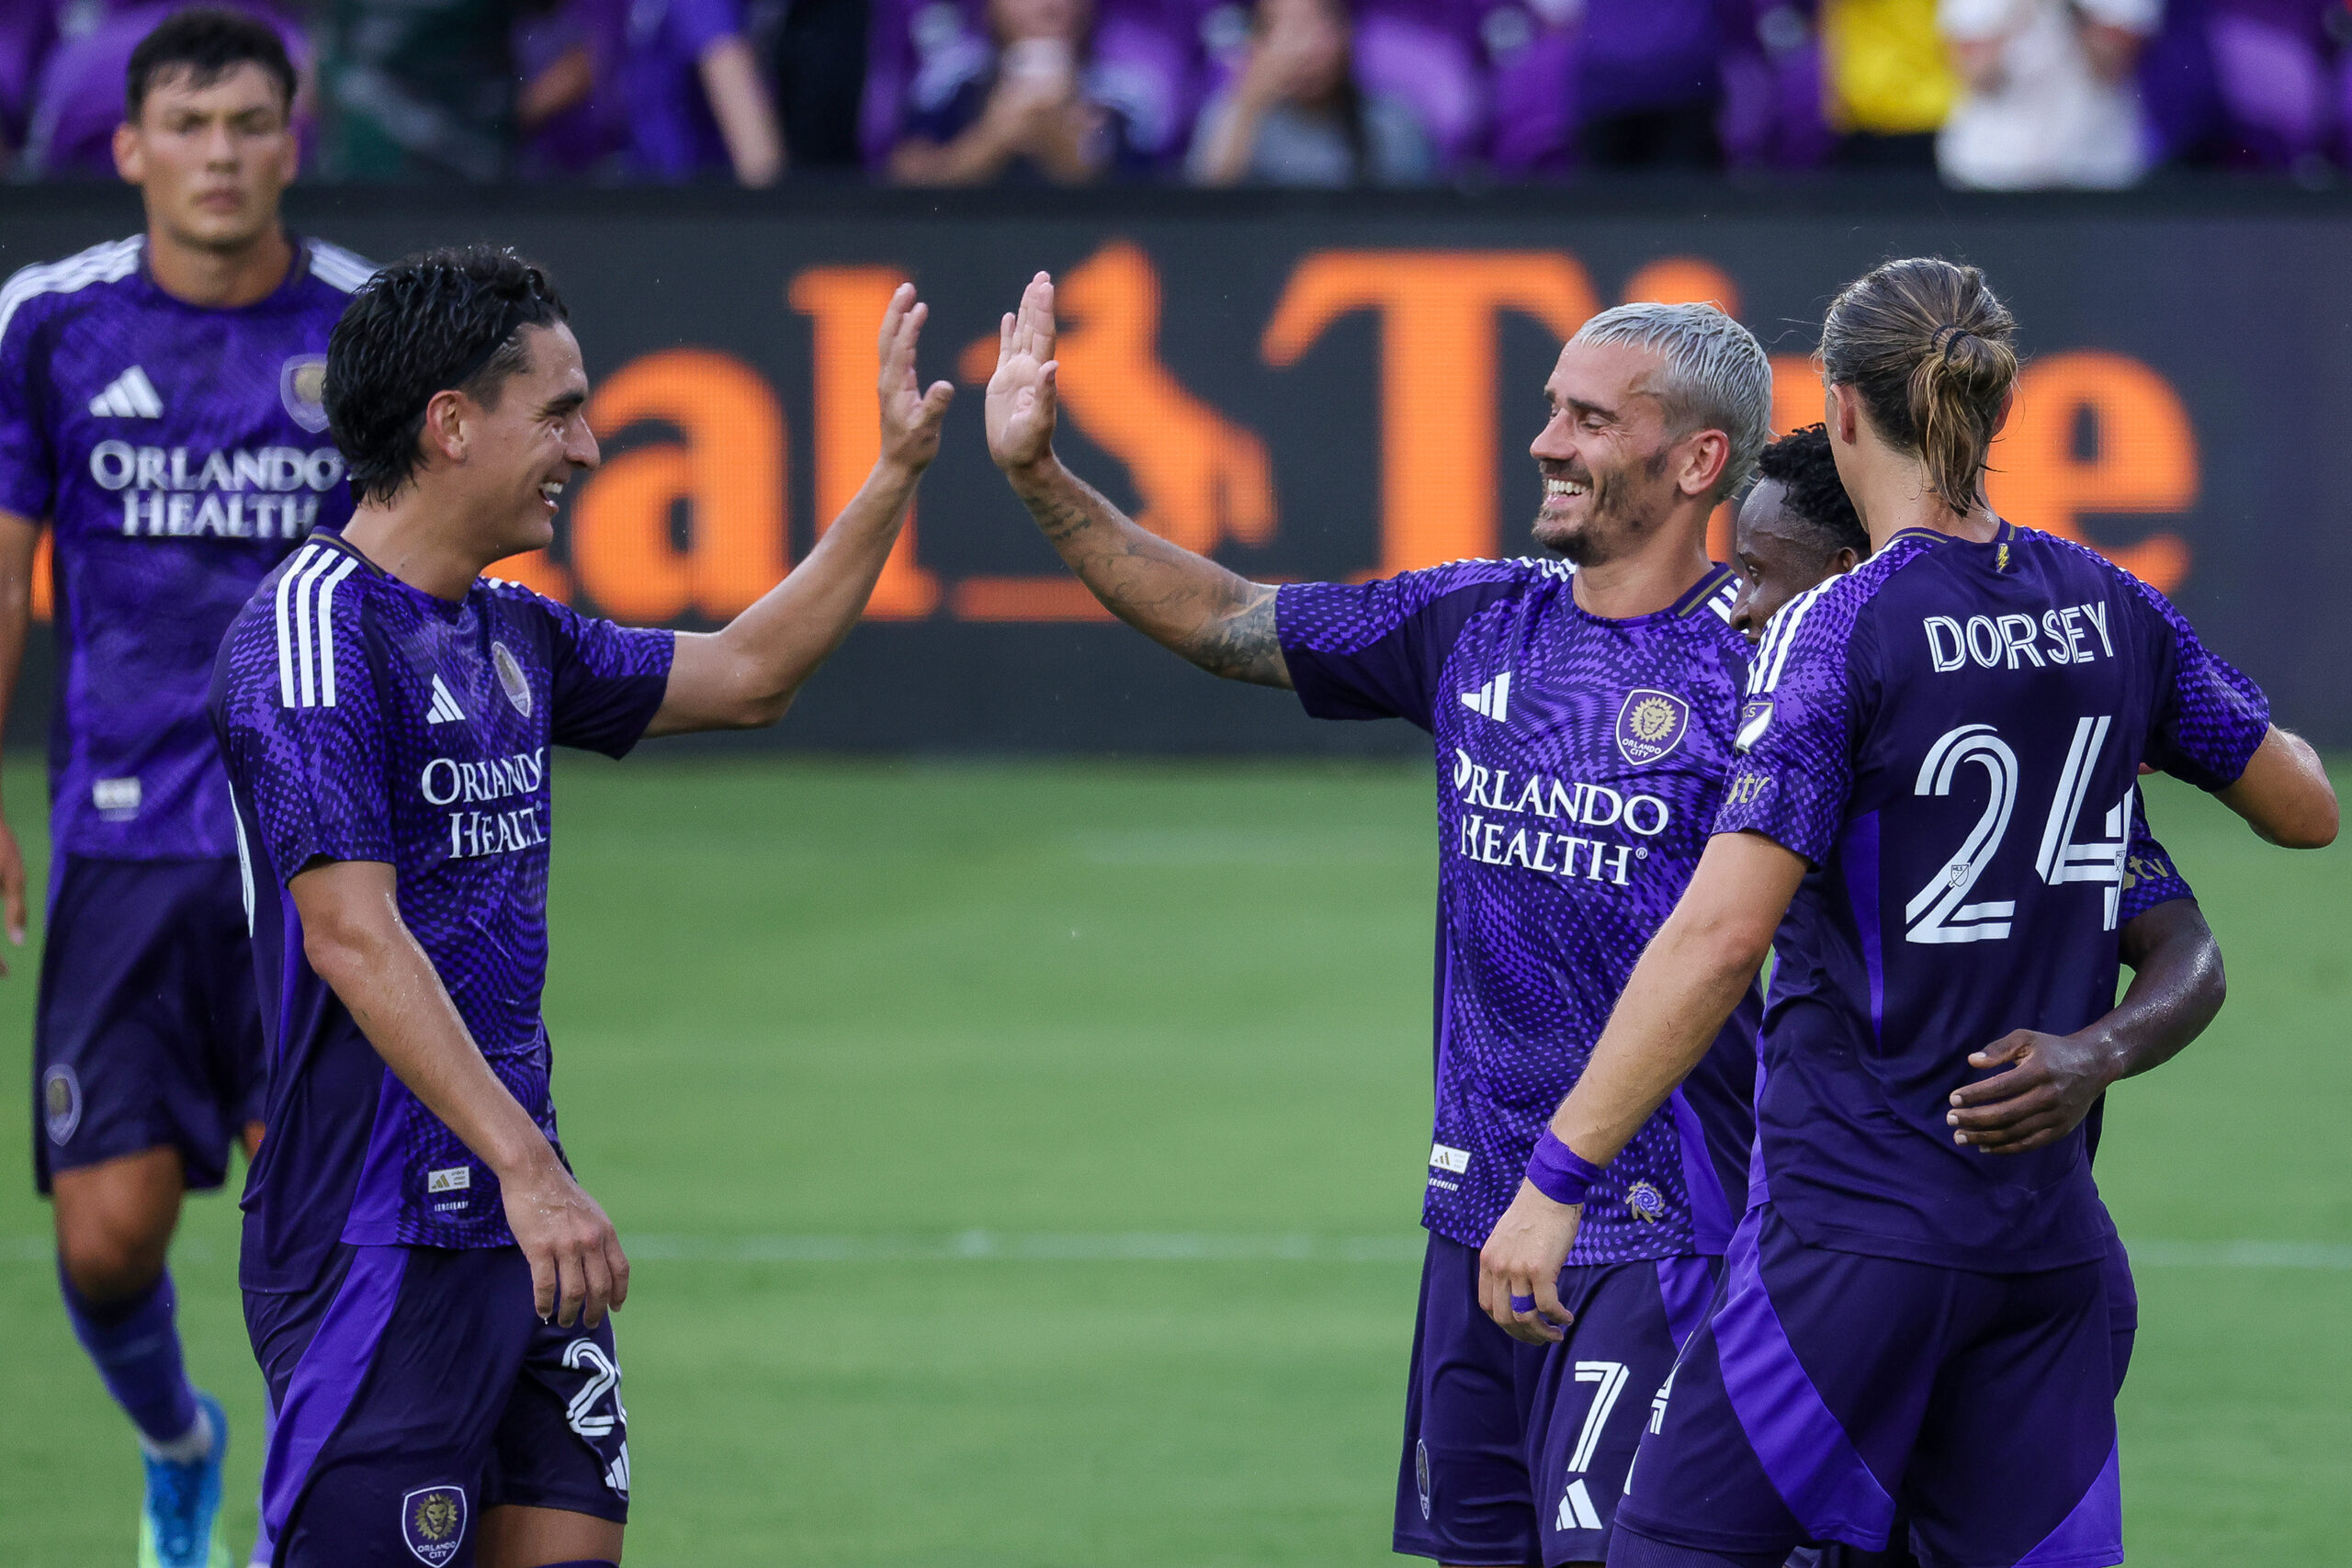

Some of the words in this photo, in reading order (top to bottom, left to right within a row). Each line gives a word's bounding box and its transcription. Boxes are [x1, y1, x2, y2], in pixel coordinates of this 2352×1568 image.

[89, 439, 345, 491] ORLANDO
[123, 489, 318, 538] HEALTH
[1923, 601, 2114, 672] DORSEY
[1622, 738, 1663, 756] ORLANDO
[1629, 747, 1650, 759] CITY
[1905, 716, 2133, 943] 24
[2127, 855, 2170, 881] tv
[562, 1337, 627, 1438] 2
[1567, 1360, 1631, 1472] 7
[416, 1540, 458, 1553] ORLANDO
[428, 1550, 447, 1560] CITY
